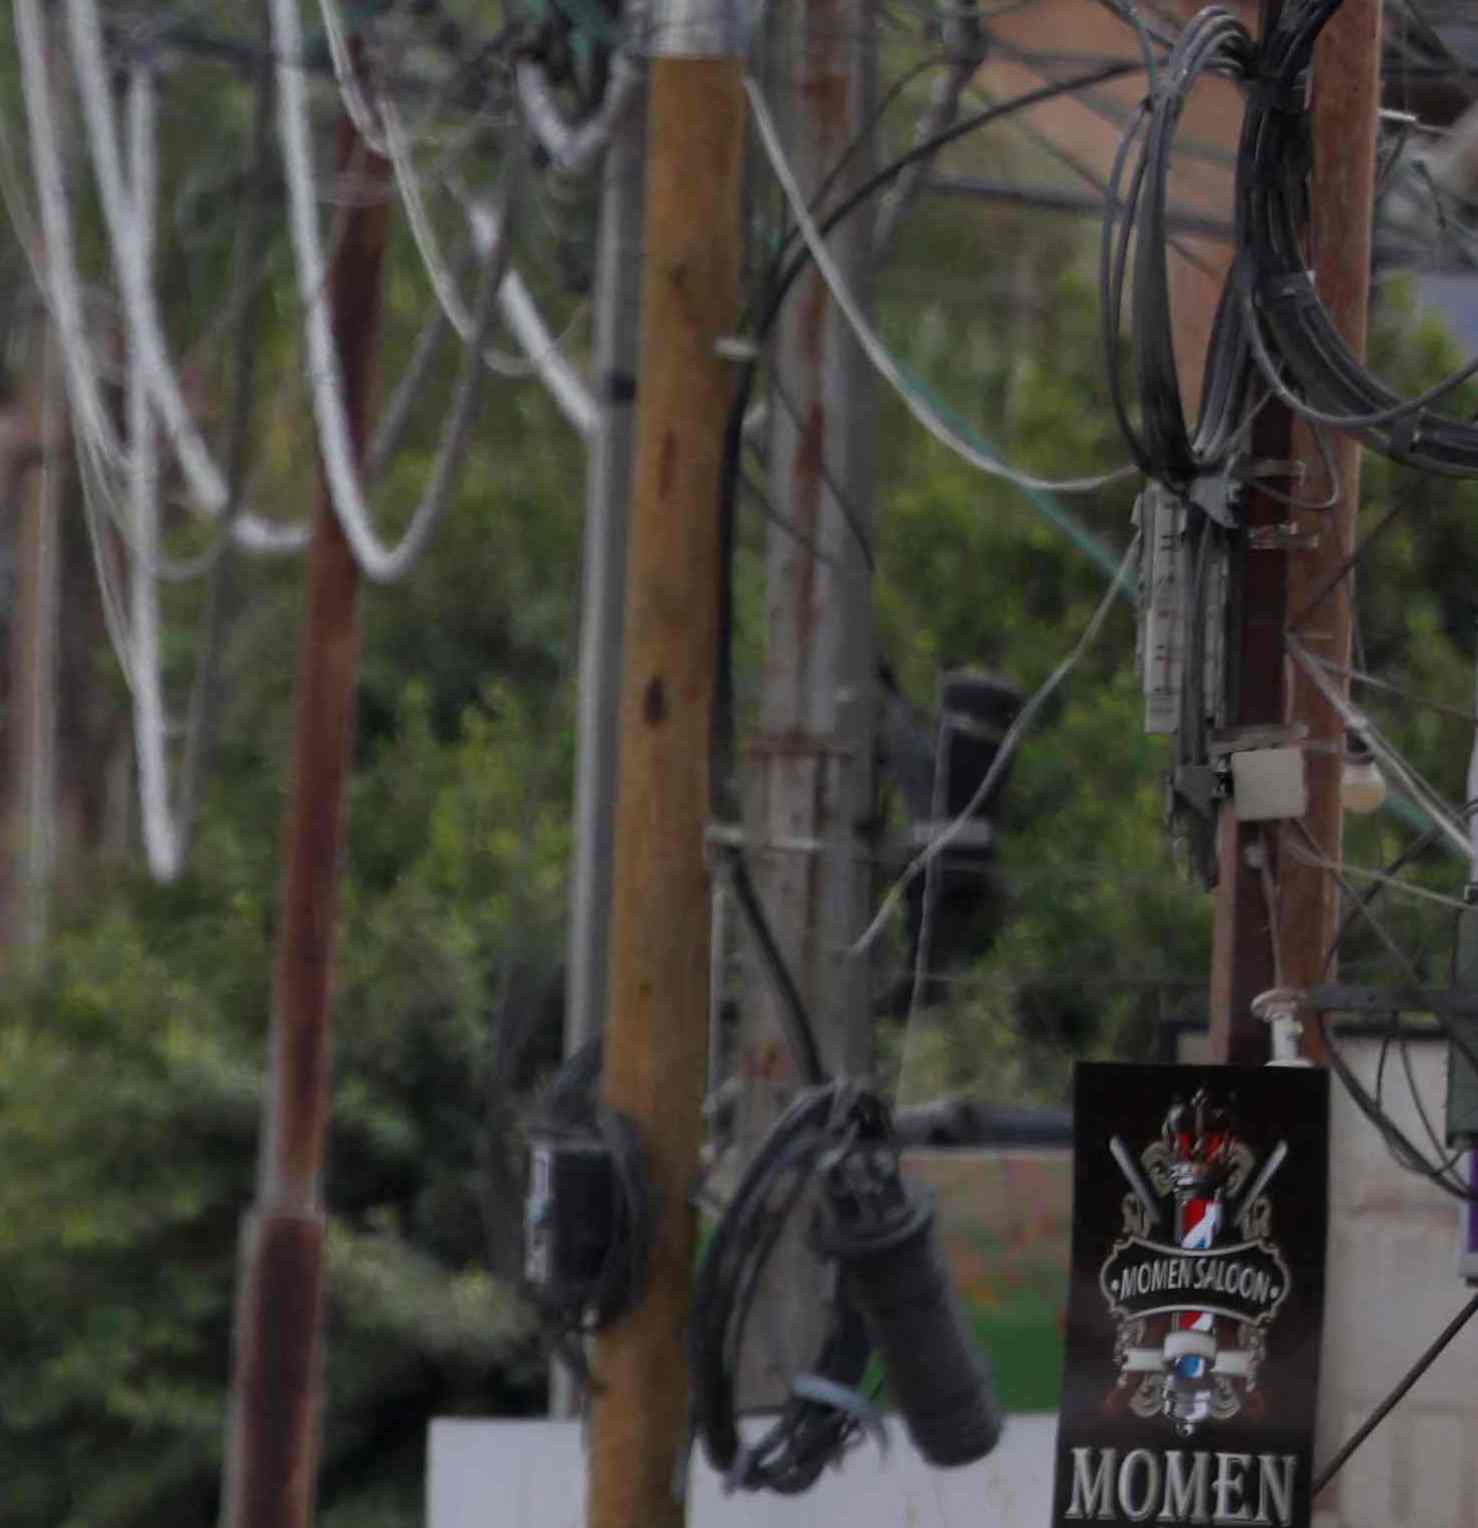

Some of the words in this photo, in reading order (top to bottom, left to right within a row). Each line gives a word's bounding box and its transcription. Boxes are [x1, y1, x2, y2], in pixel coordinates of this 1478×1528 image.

[1119, 1257, 1192, 1301] MOMEN
[1193, 1257, 1271, 1304] SALOON
[1064, 1447, 1297, 1527] MOMEN
